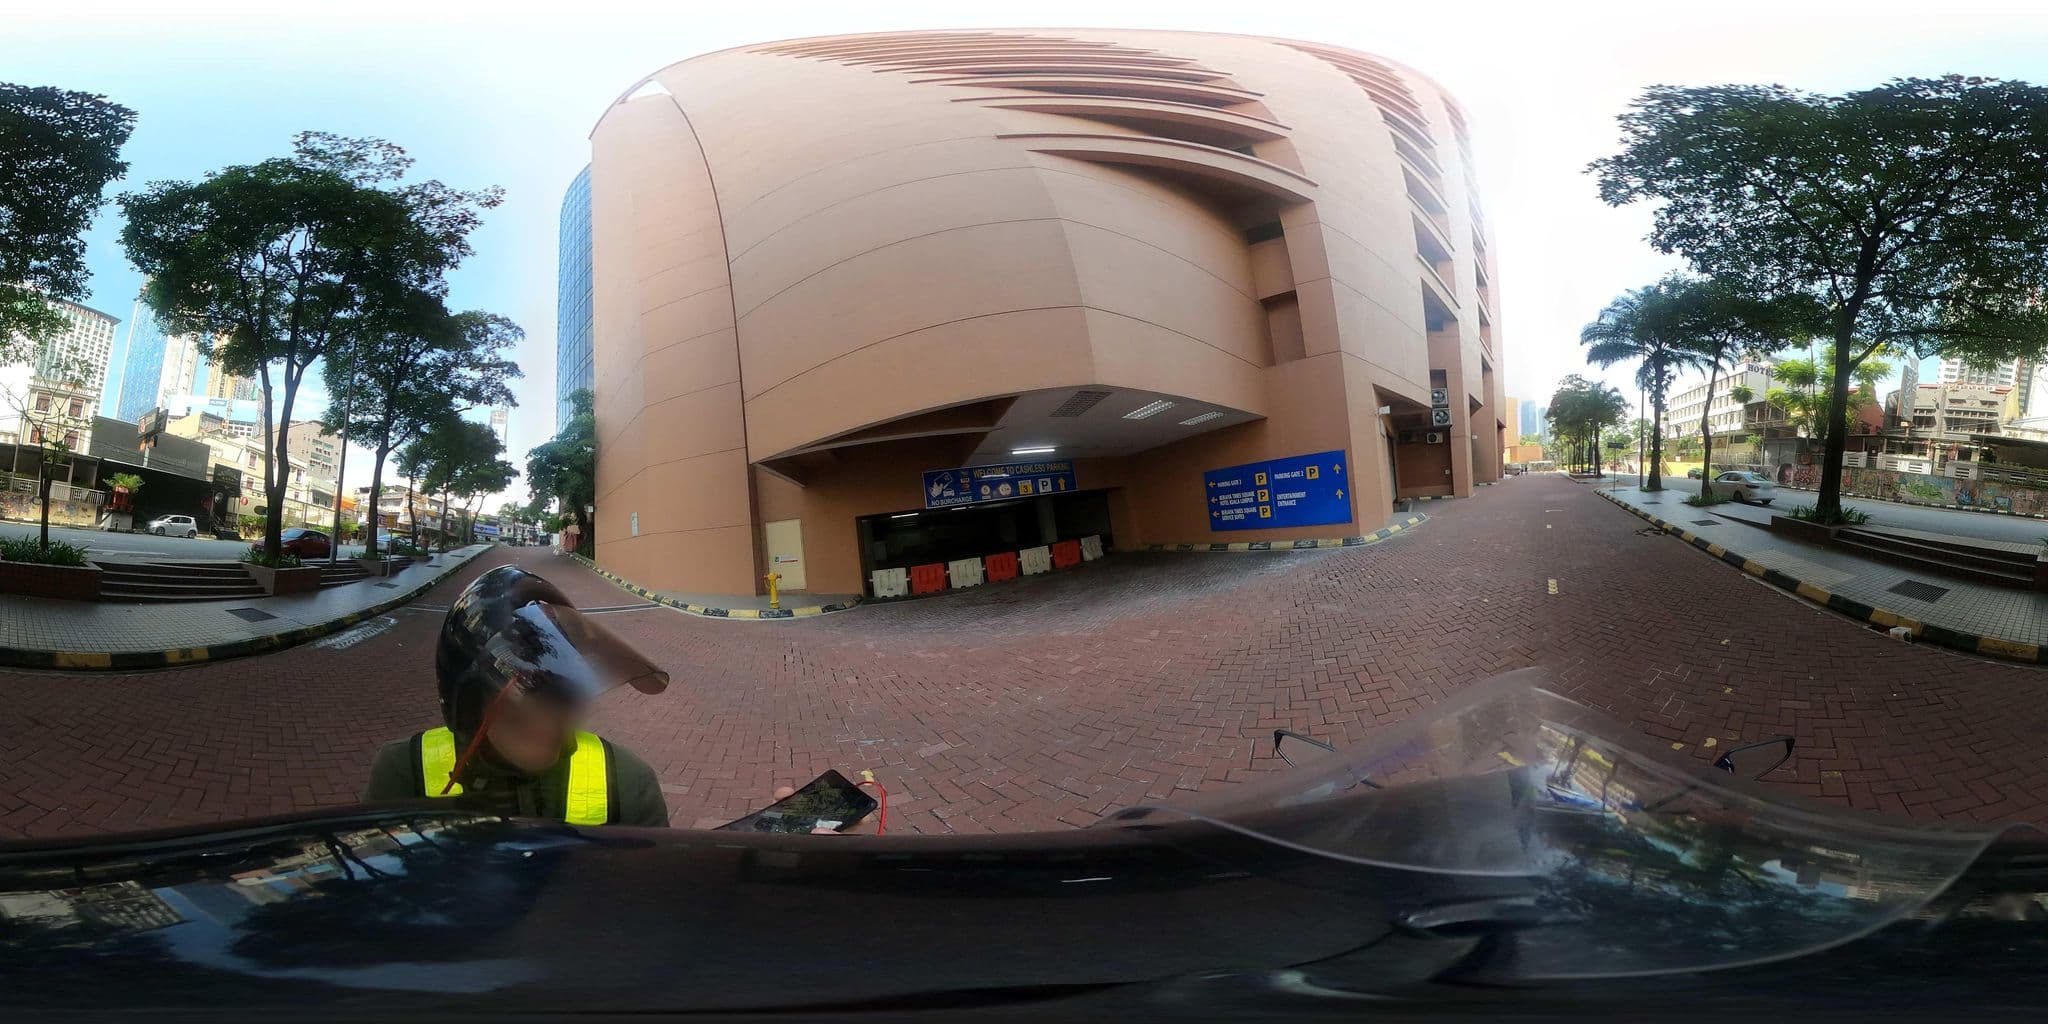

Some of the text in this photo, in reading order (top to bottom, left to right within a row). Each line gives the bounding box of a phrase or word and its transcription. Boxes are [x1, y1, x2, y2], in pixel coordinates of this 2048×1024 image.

[973, 466, 1006, 479] WELCOME
[1006, 466, 1015, 475] TO
[1015, 463, 1046, 474] CASHLESS
[1274, 472, 1290, 480] PARKING
[940, 496, 973, 506] SURCHARGE
